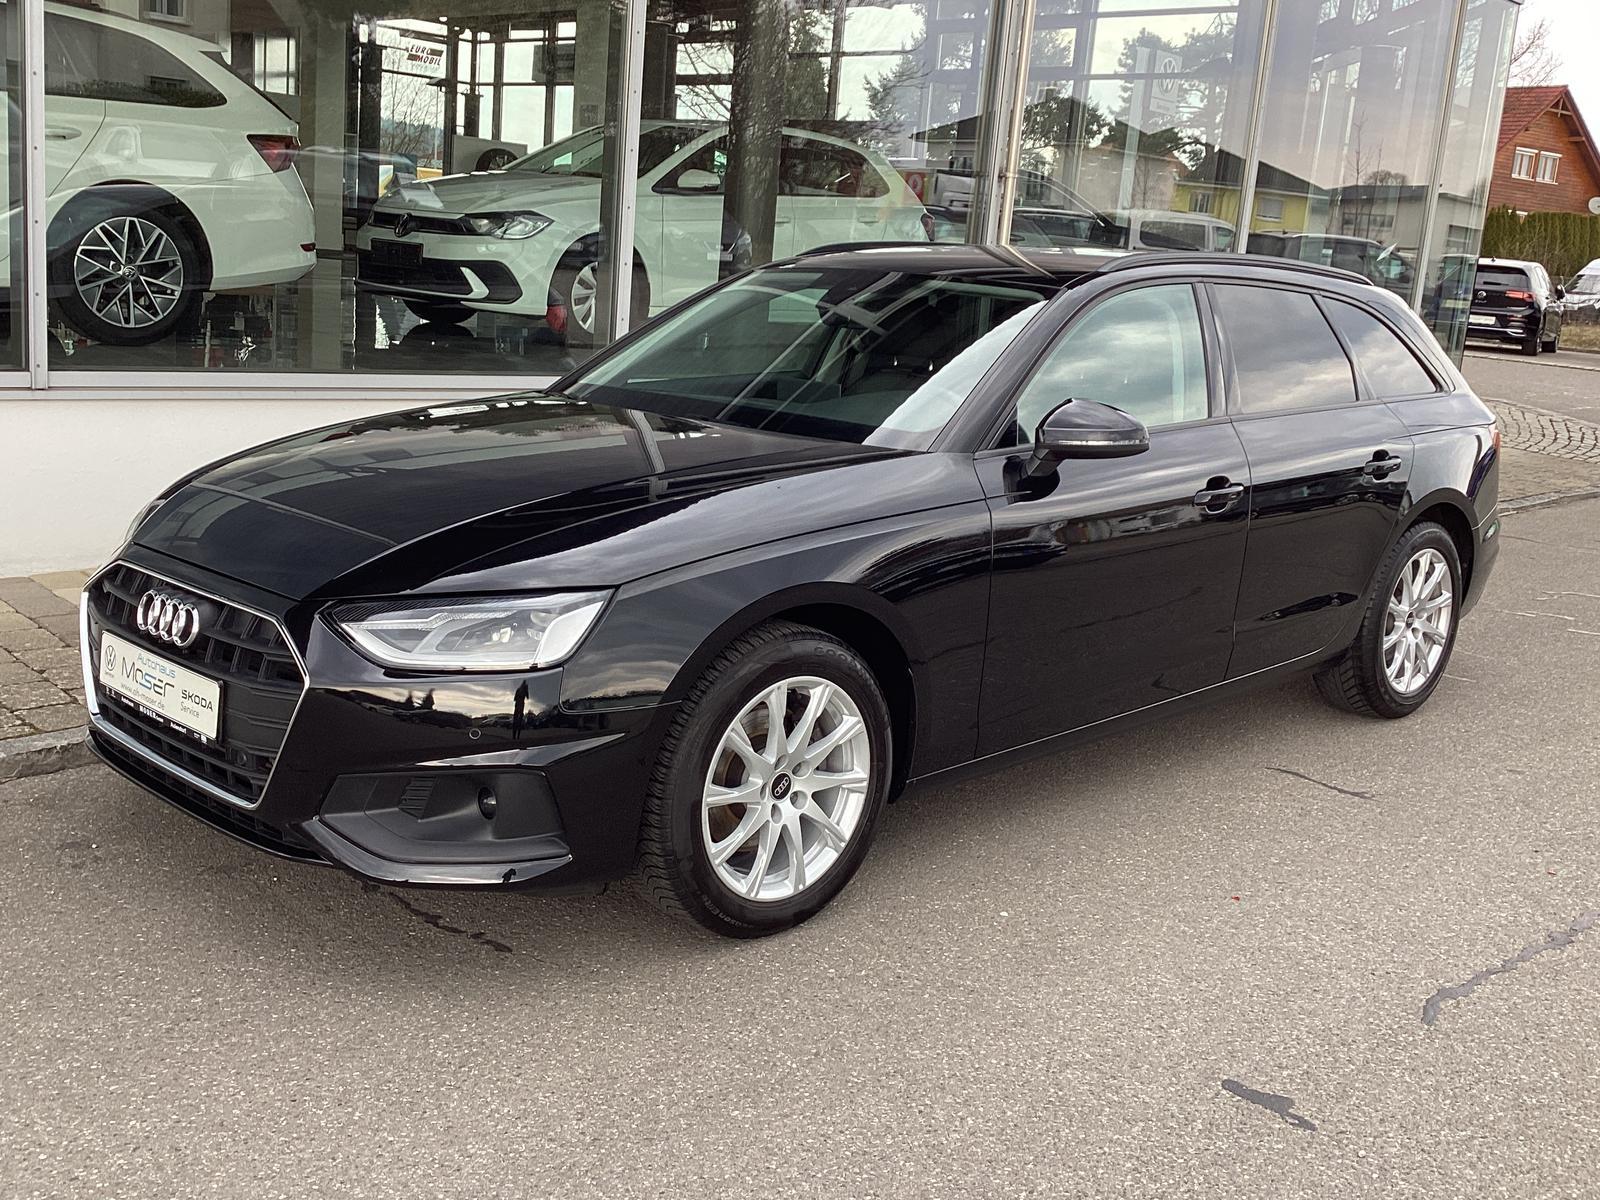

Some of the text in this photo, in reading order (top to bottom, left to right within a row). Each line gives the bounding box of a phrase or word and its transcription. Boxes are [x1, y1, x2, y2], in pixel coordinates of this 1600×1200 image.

[416, 55, 441, 66] MOBIL
[137, 652, 177, 679] Autohaus
[180, 701, 200, 718] Service
